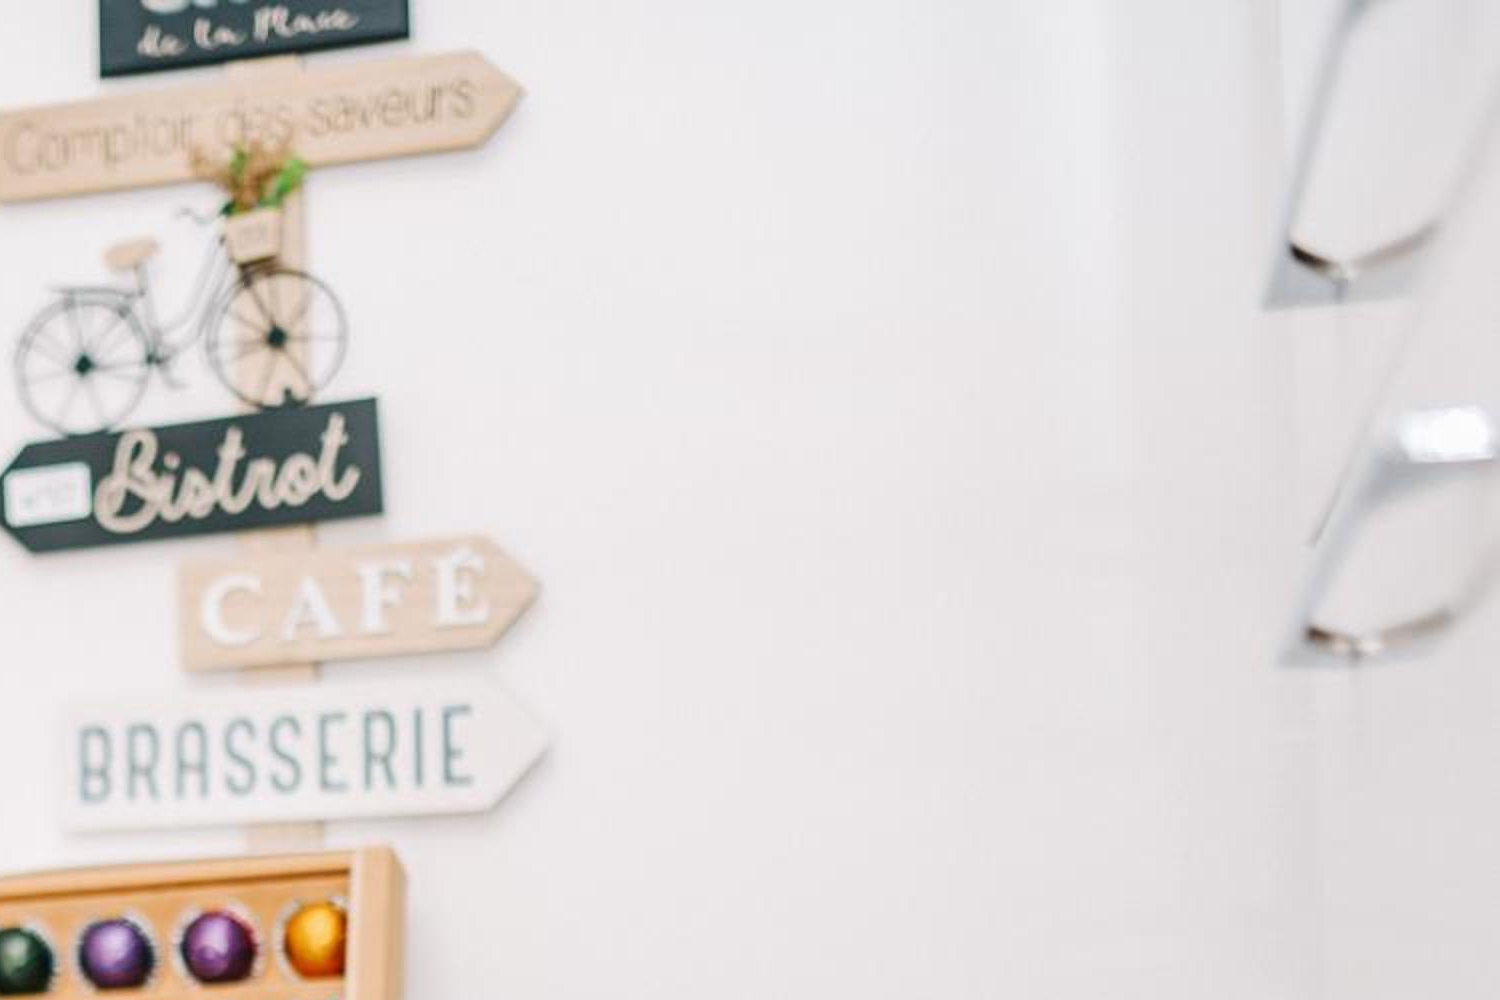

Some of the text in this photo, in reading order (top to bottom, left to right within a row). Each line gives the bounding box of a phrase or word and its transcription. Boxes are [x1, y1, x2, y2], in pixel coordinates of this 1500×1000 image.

[137, 24, 188, 58] de
[194, 17, 248, 50] la
[254, 4, 358, 43] Place
[4, 79, 477, 175] Comptoir des saveurs
[95, 412, 359, 533] Bistrot
[201, 547, 490, 645] CAFÉ
[79, 705, 474, 804] BRASSERIE
